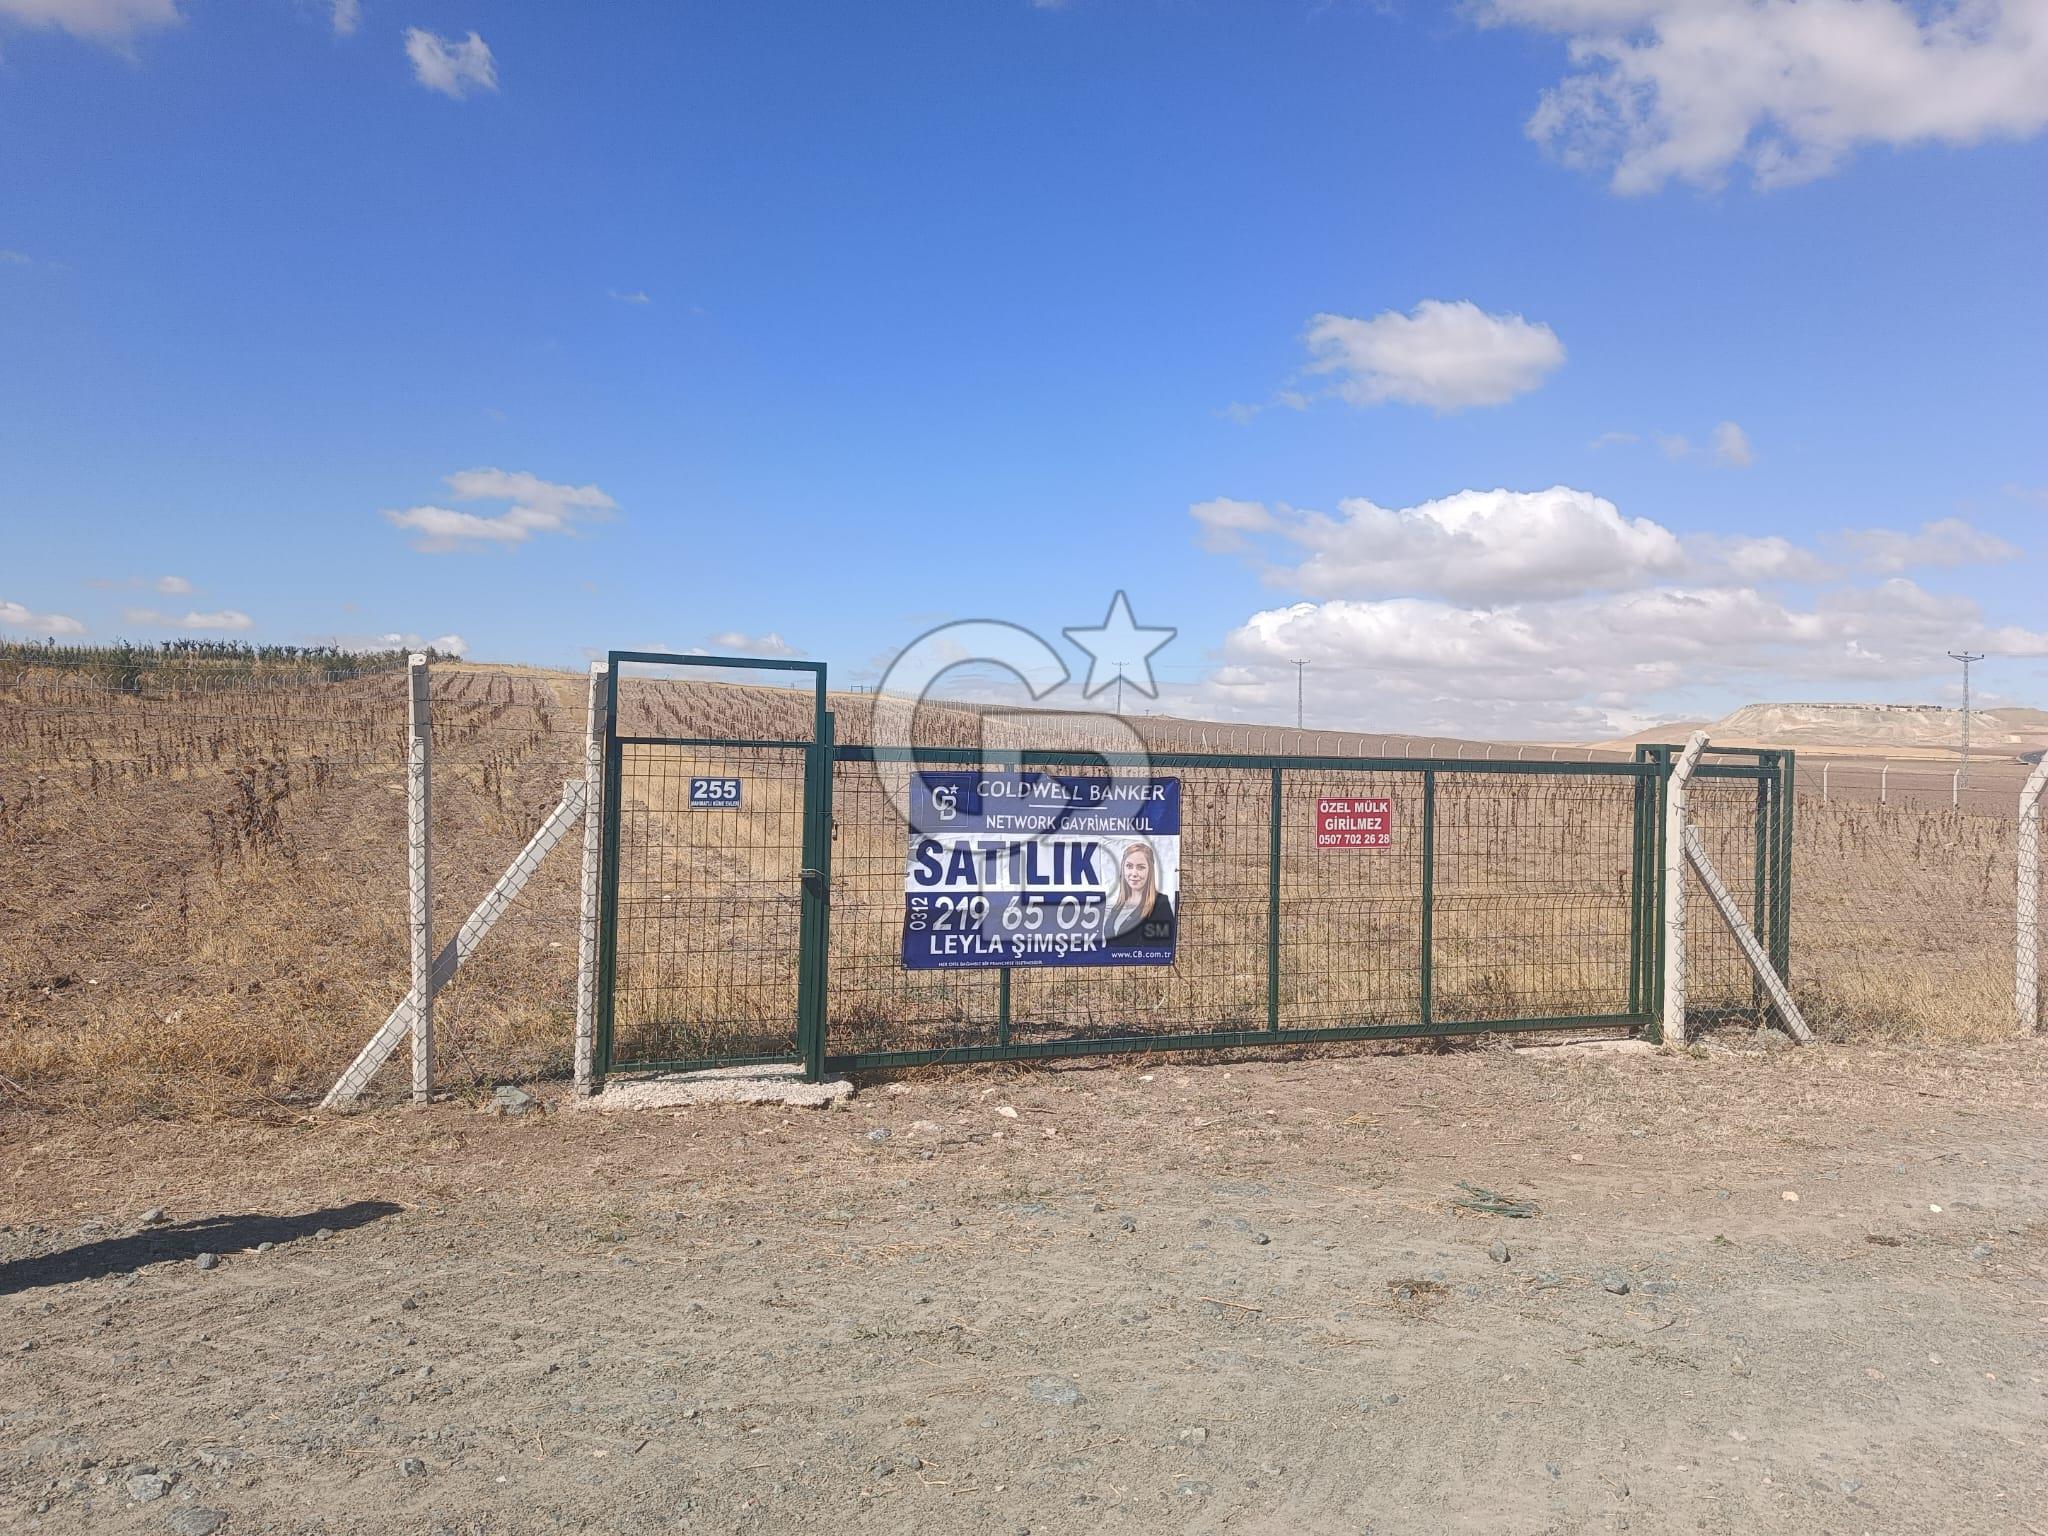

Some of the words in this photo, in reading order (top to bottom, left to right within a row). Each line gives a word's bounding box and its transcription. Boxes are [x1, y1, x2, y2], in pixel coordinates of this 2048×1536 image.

[693, 780, 737, 799] 255
[976, 781, 1083, 800] COLDWELL
[1089, 784, 1166, 801] BANKER
[1320, 800, 1351, 813] ÖZEL
[1354, 800, 1388, 813] MÜLK
[986, 814, 1056, 830] NETWORK
[1061, 814, 1153, 831] GAYRİMENKUL
[1325, 815, 1382, 830] GİRİLMEZ
[1319, 834, 1342, 845] 0507
[1344, 834, 1362, 844] 702
[1364, 833, 1376, 844] 26
[1378, 833, 1390, 844] 28
[914, 838, 1100, 887] SATILIK
[909, 896, 929, 931] 0312
[932, 895, 990, 931] 219
[1002, 895, 1044, 930] 65
[1056, 895, 1101, 930] 05
[930, 934, 1004, 955] LEYLA
[1111, 950, 1172, 959] www.CB.com.tr
